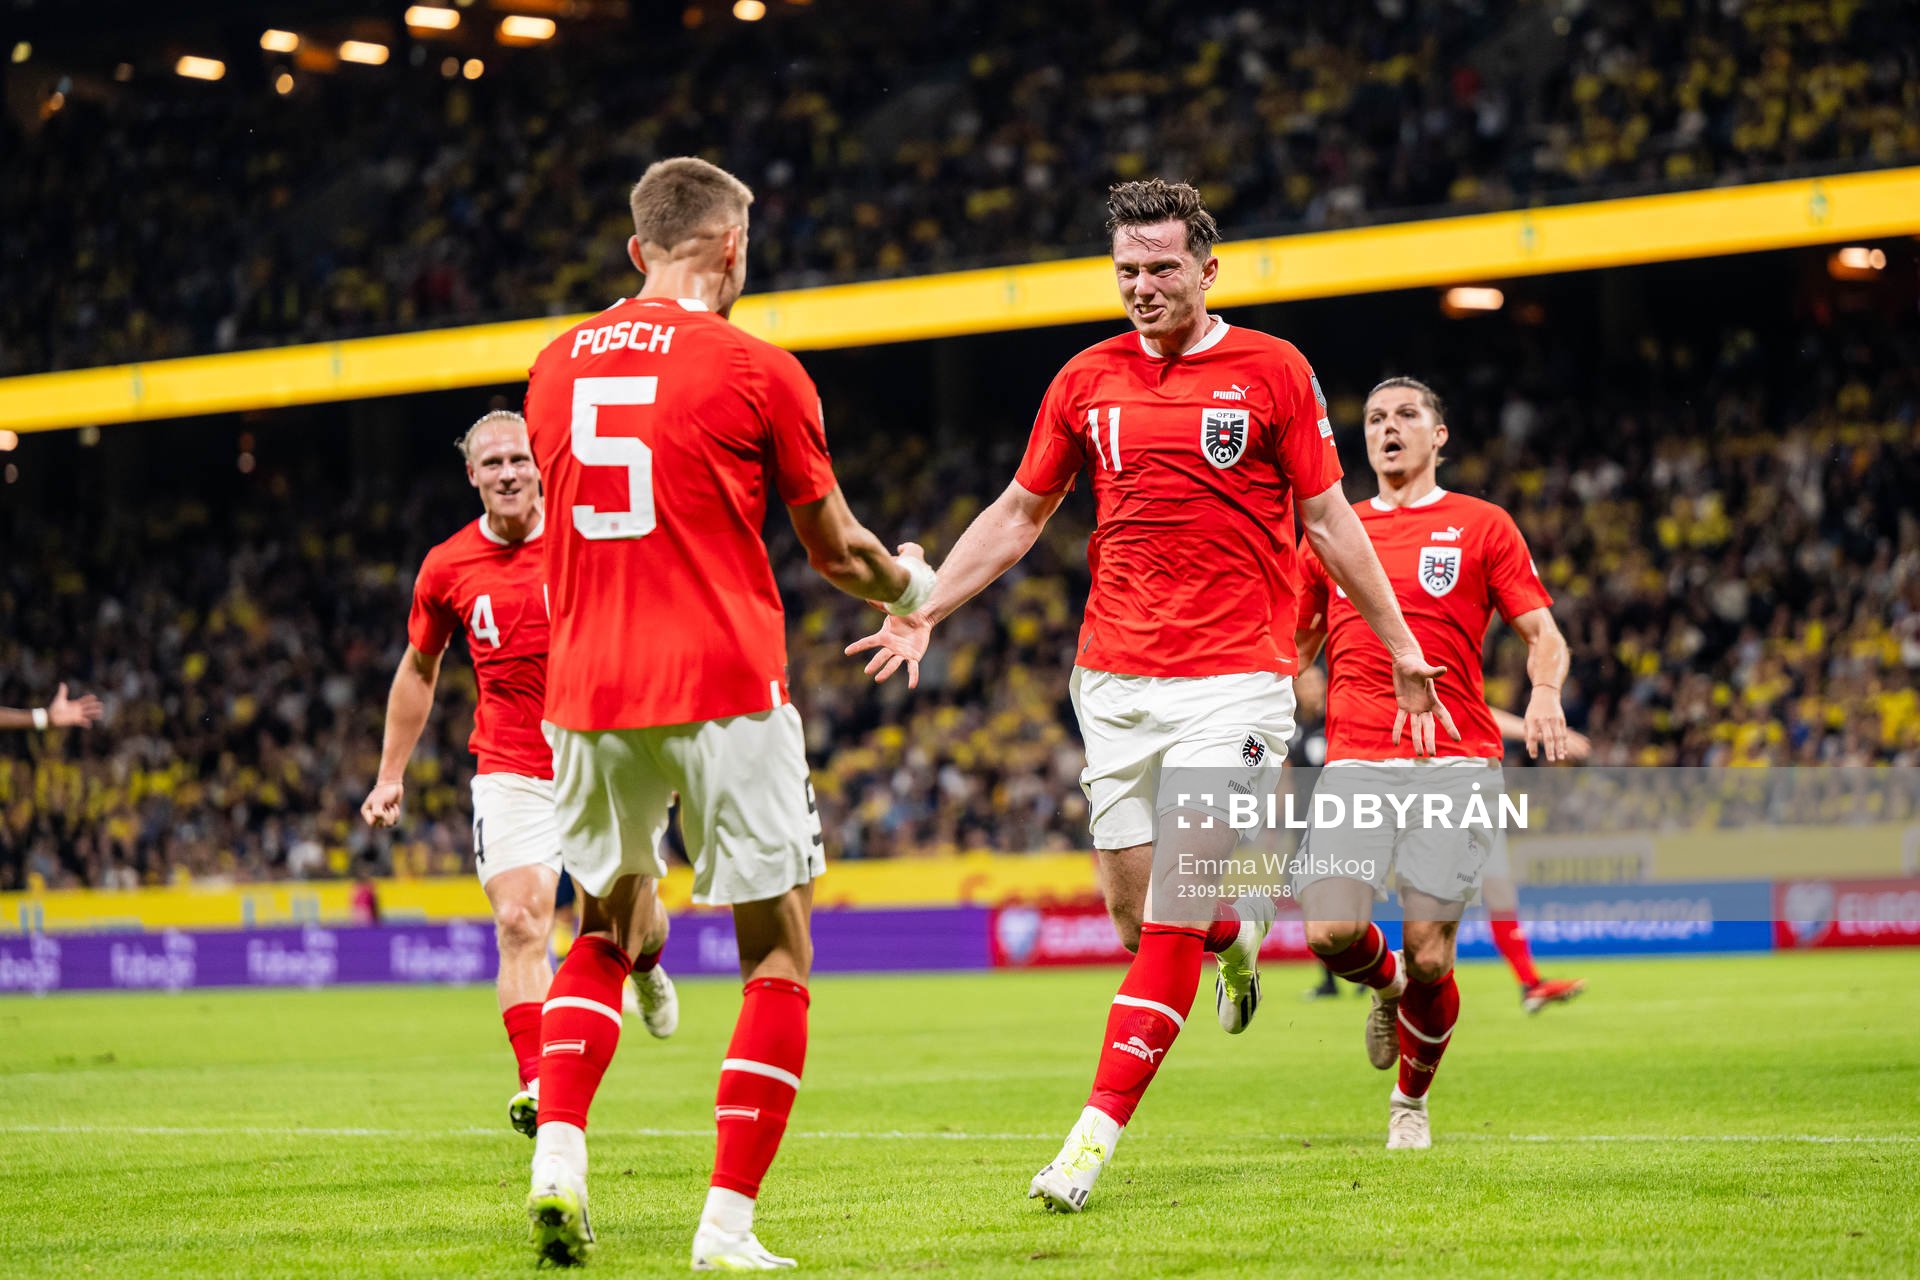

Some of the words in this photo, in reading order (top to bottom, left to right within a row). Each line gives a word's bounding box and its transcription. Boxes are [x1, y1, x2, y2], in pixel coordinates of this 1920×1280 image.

[571, 321, 675, 358] POSCH
[1213, 390, 1241, 400] PUMA
[571, 376, 658, 540] 5
[1088, 407, 1122, 471] 11
[471, 594, 500, 648] 4
[1112, 1041, 1147, 1061] PUMA
